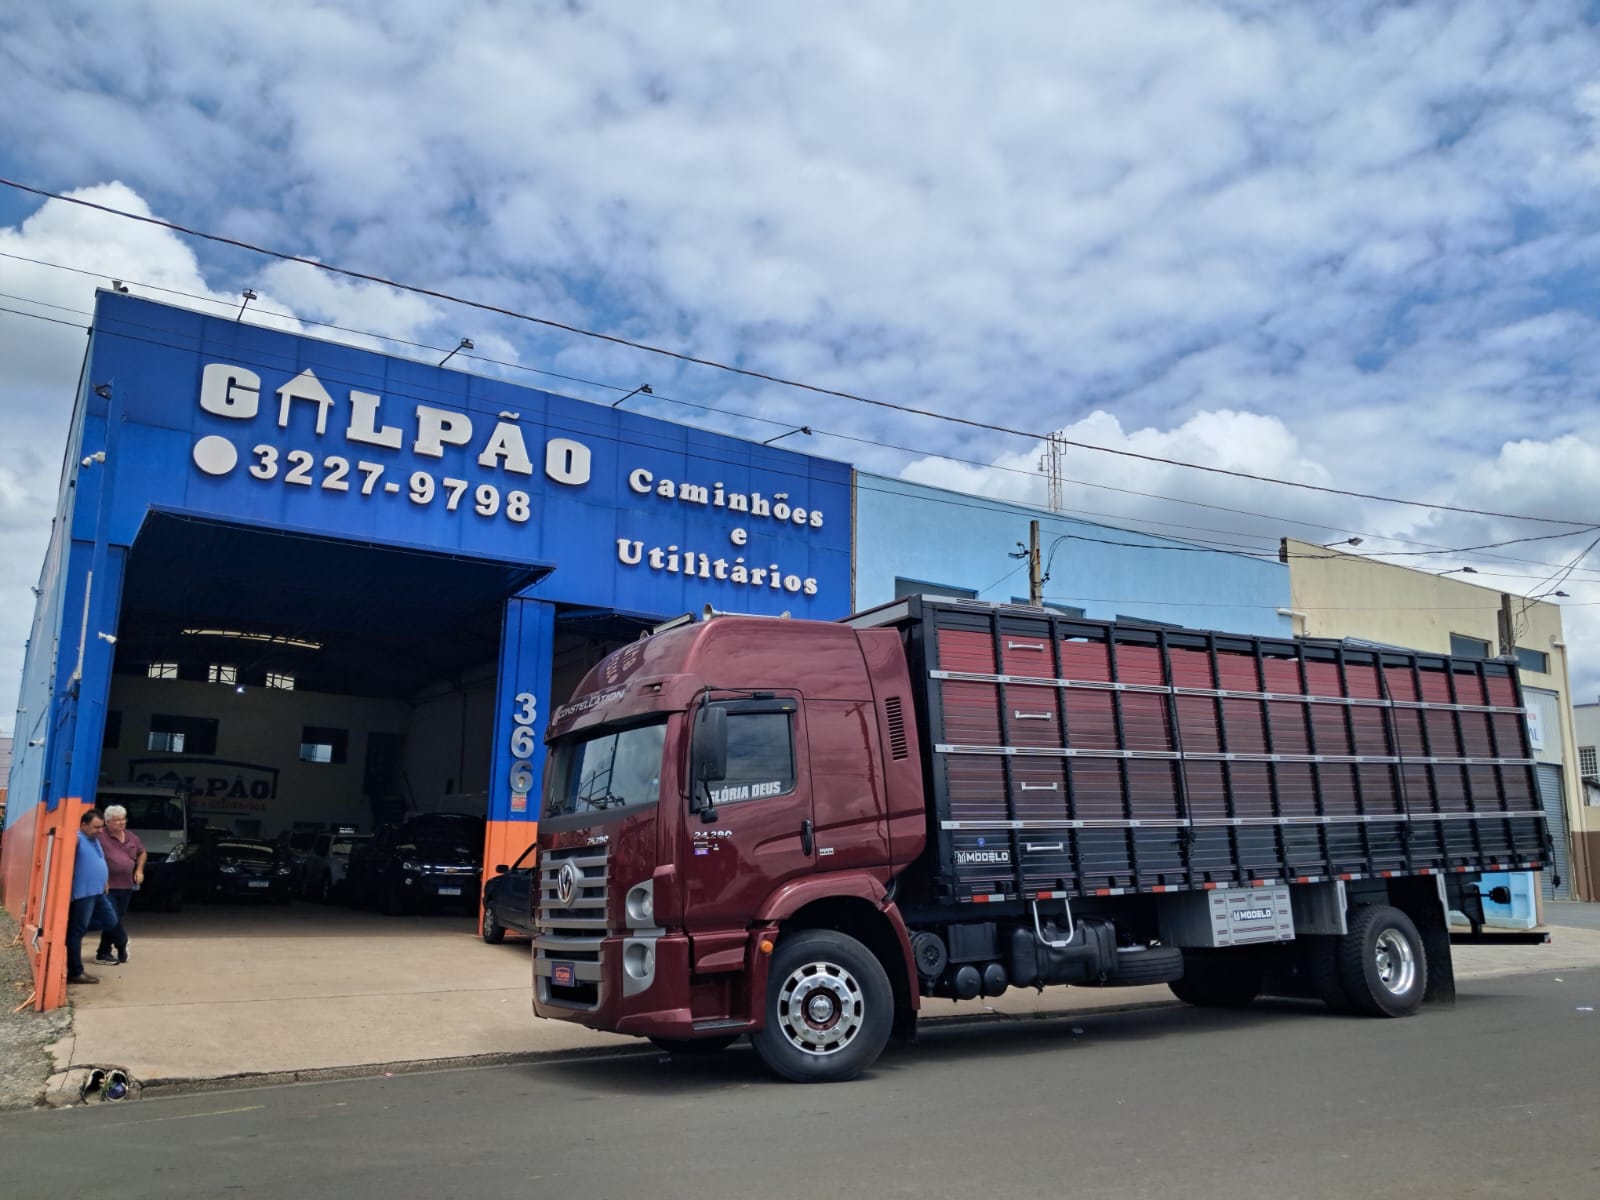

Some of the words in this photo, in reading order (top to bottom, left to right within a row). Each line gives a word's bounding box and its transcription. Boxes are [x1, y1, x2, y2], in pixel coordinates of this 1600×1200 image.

[249, 444, 531, 522] 3227-9798
[629, 468, 824, 528] Caminhões
[730, 528, 748, 546] e
[616, 538, 818, 595] Utilitários
[509, 692, 537, 793] 366
[752, 781, 781, 797] DEUS
[966, 852, 1009, 863] MODELO
[1240, 909, 1272, 920] MODELO
